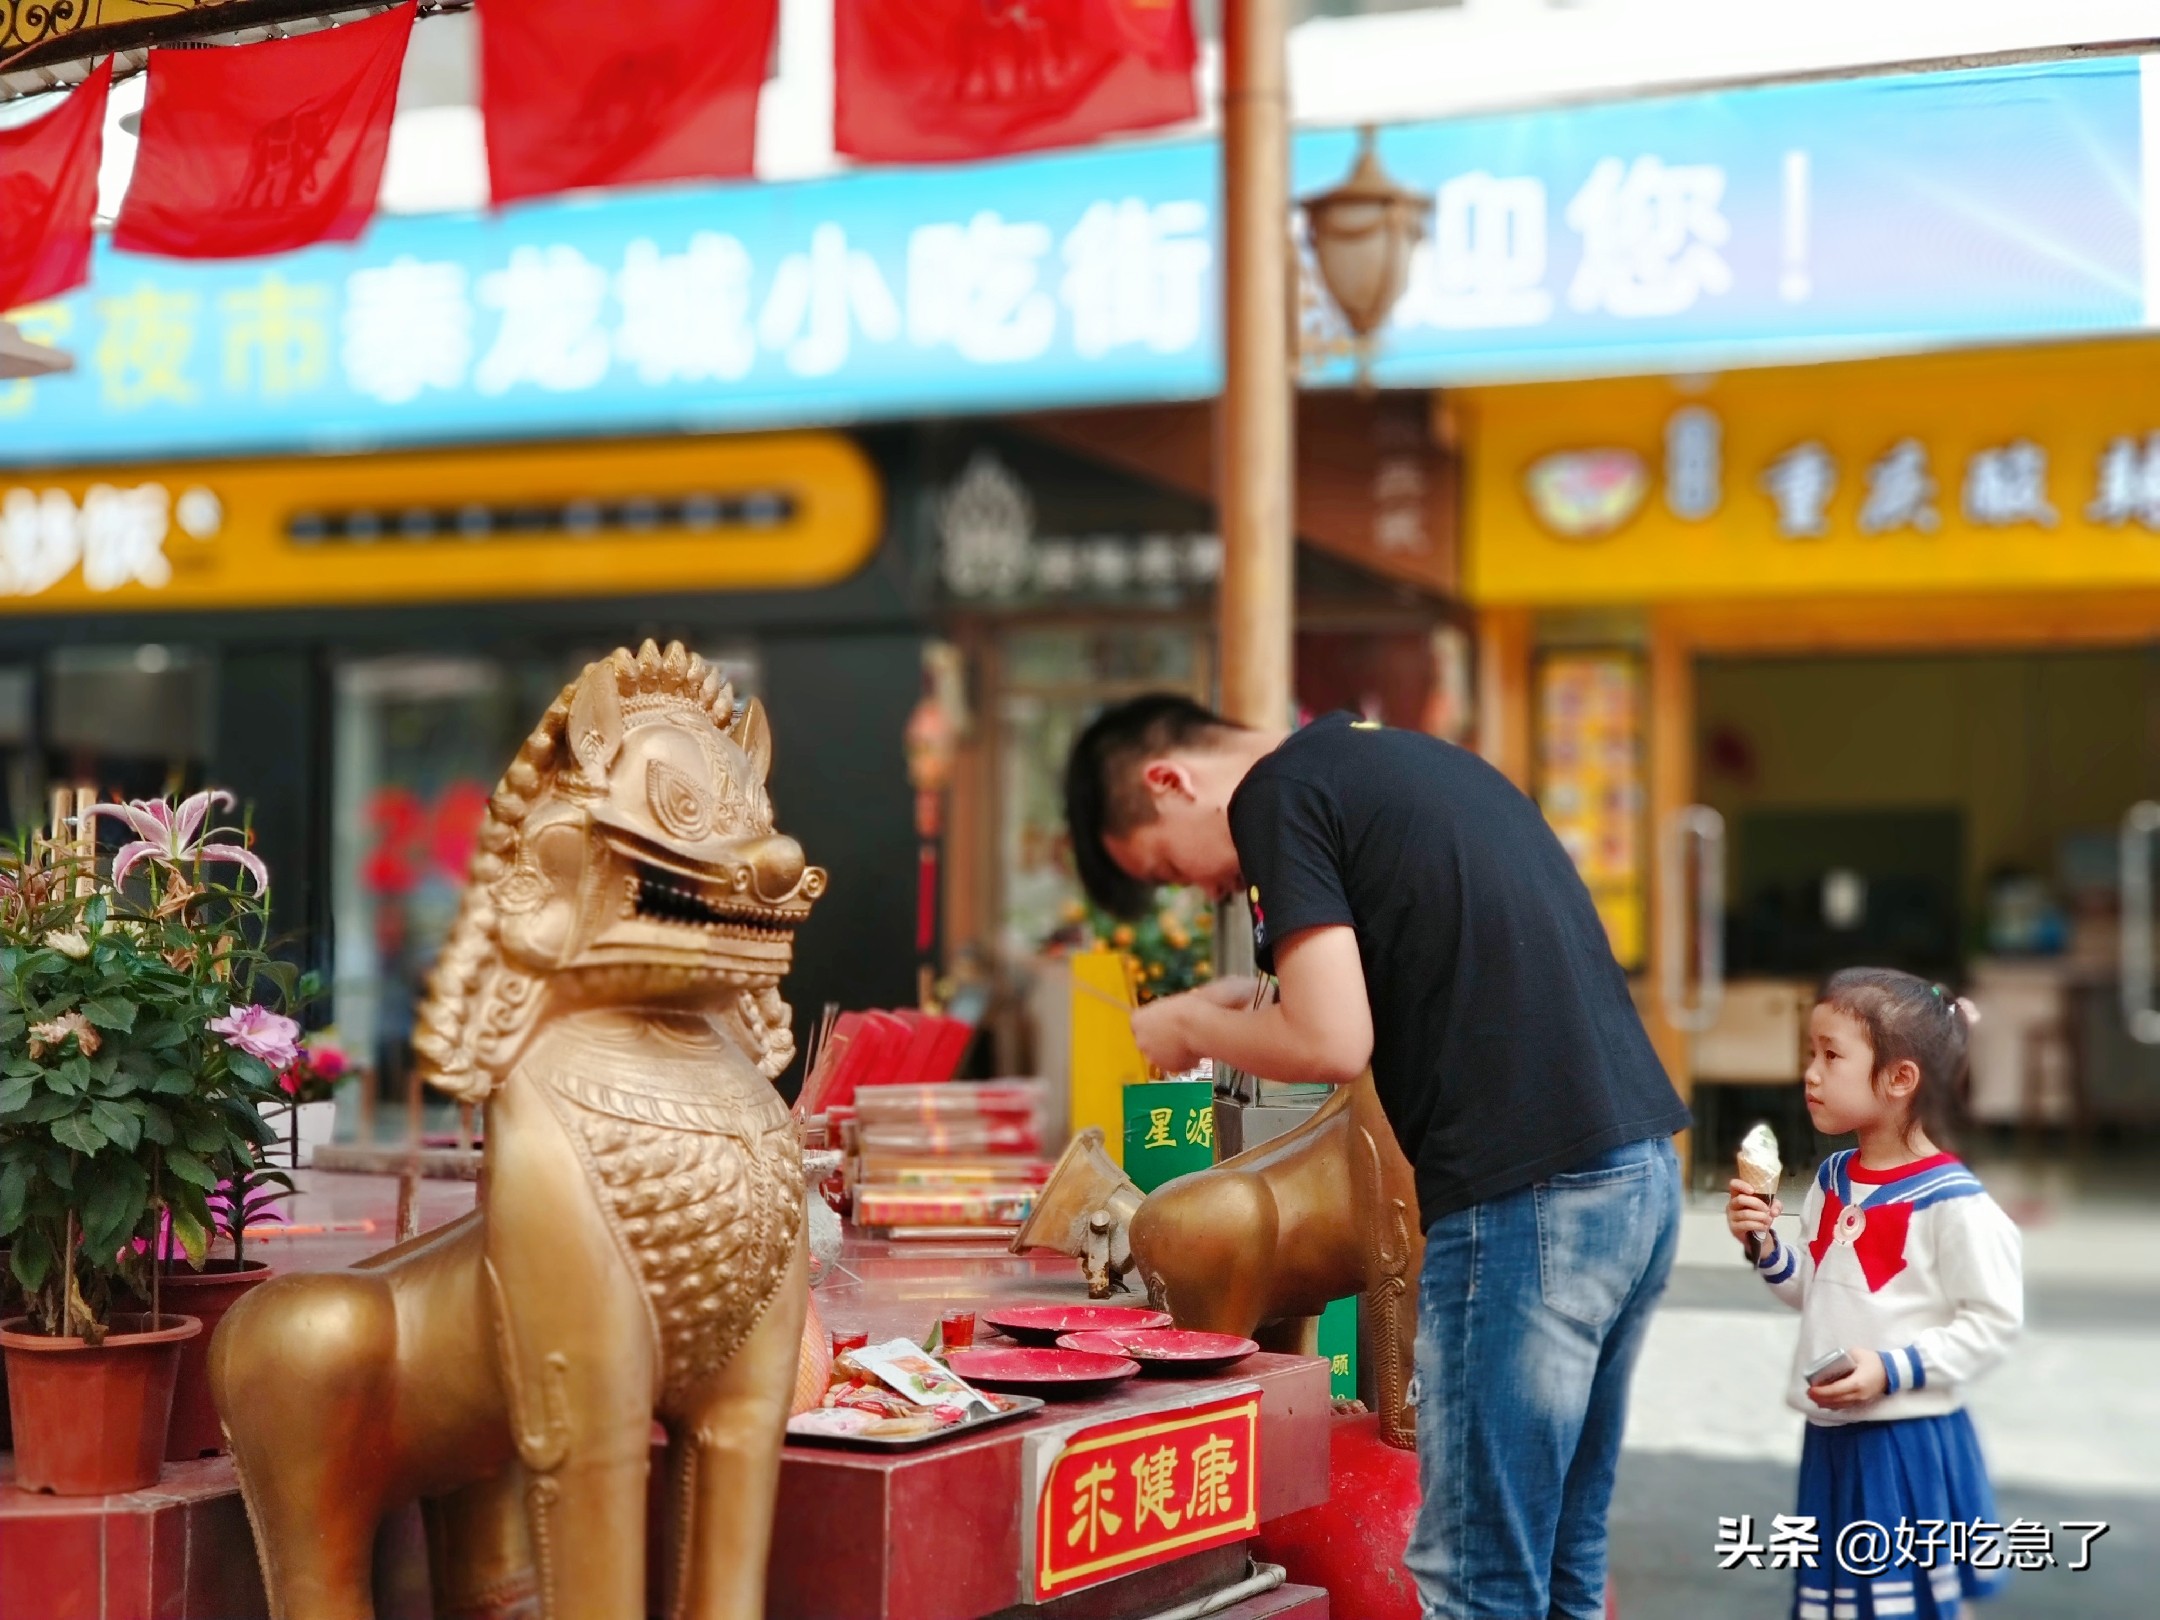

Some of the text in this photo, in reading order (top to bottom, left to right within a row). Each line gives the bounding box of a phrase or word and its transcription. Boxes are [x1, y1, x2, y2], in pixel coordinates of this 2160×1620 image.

[1144, 1106, 1213, 1150] 星源
[1066, 1432, 1239, 1554] 求健康
